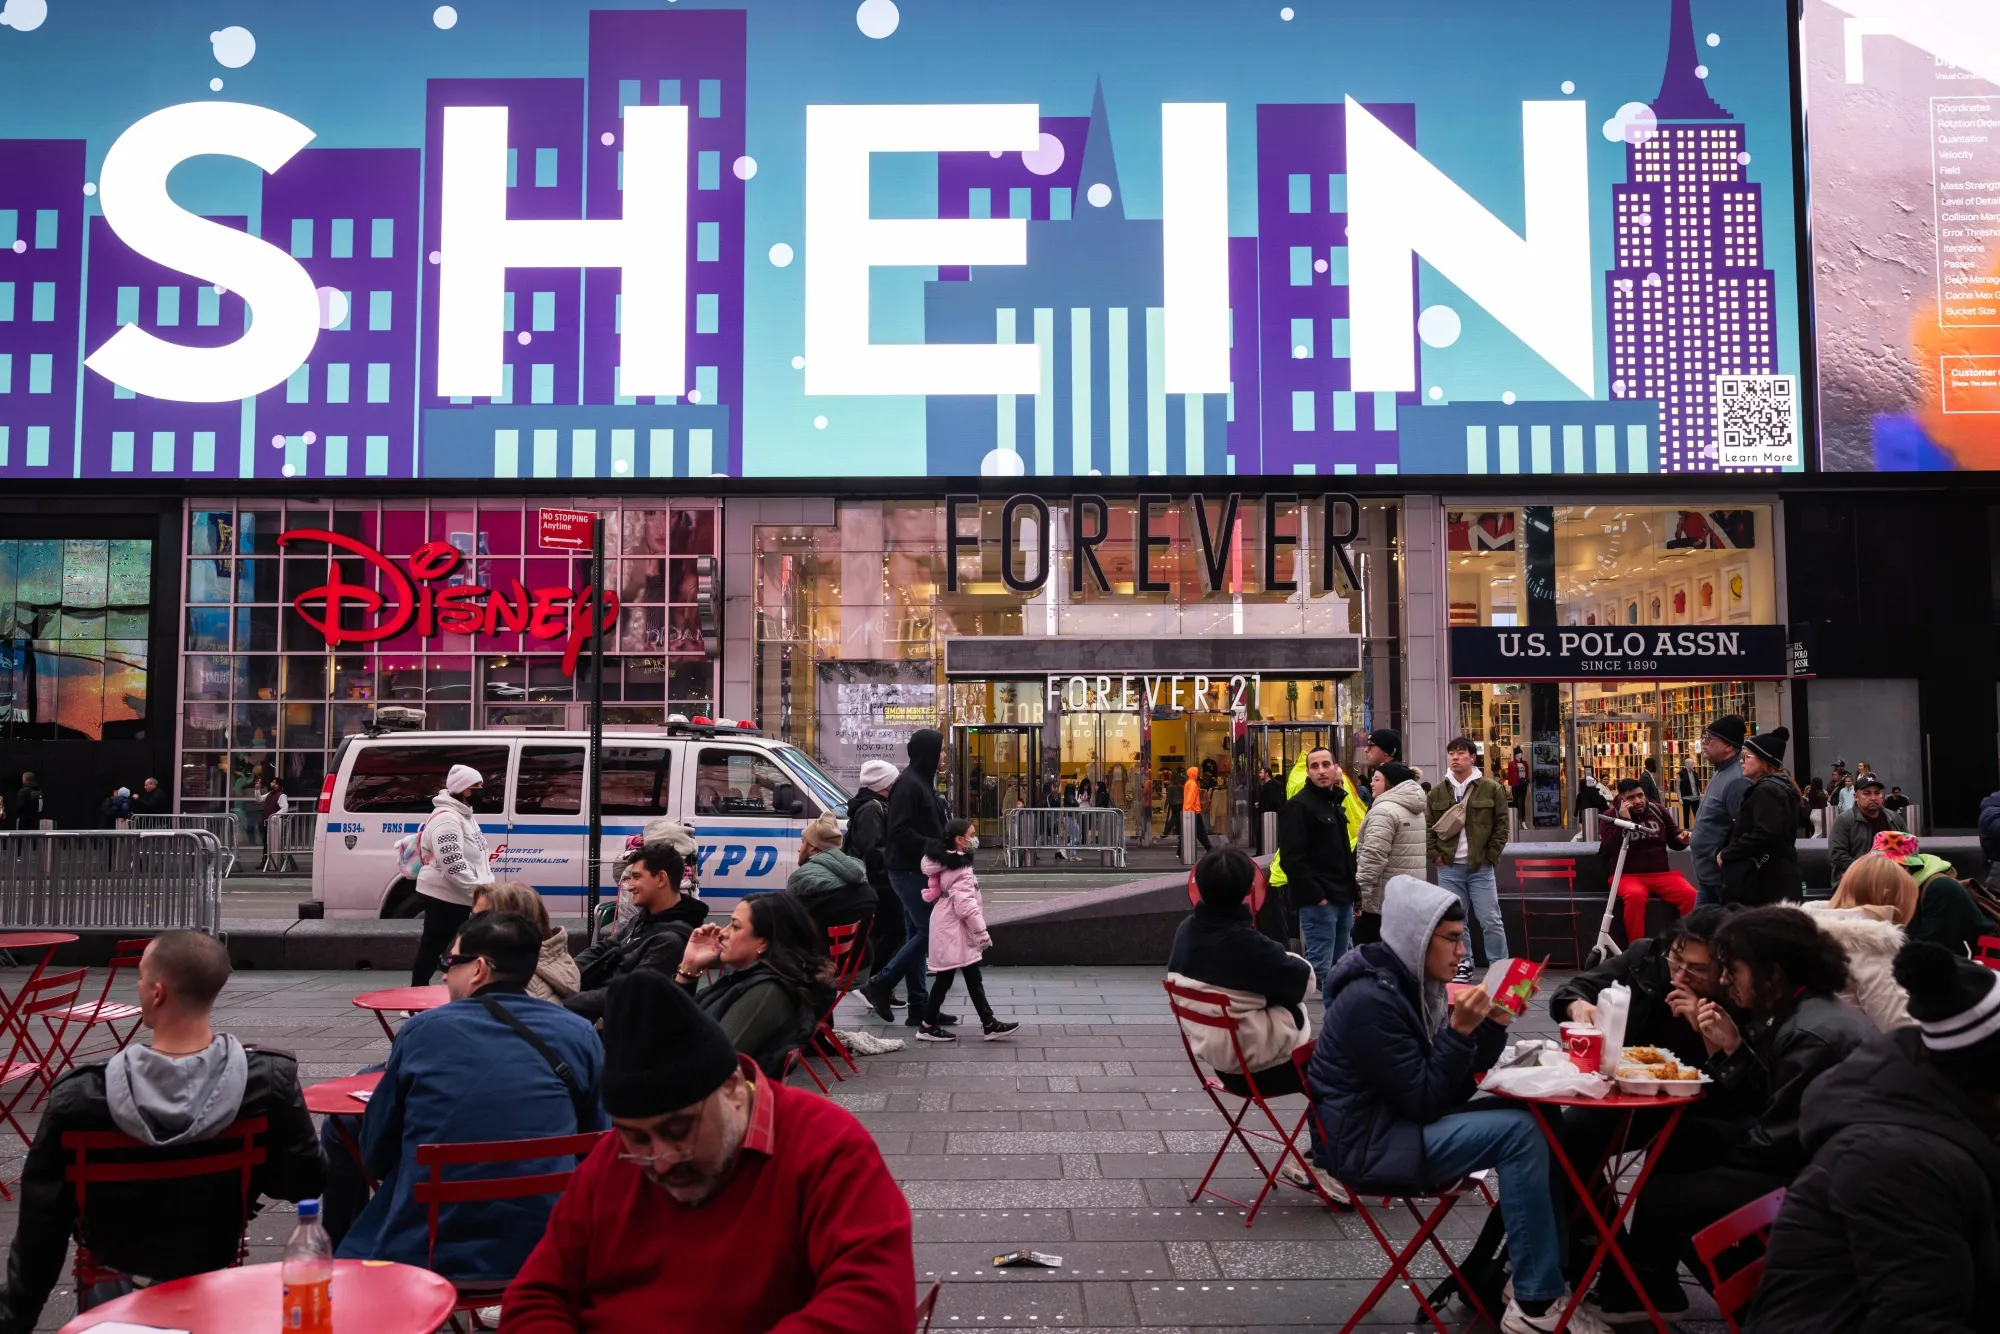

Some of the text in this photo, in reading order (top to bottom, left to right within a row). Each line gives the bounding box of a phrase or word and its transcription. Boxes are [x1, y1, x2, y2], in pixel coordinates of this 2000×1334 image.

[1937, 104, 1991, 112] Coordinates
[1938, 119, 1975, 128] Rotation
[1938, 135, 1988, 144] Quantation
[1939, 150, 1974, 160] Velocity
[1940, 166, 1960, 175] Field
[1940, 182, 1964, 190] Mass
[1942, 196, 2000, 206] Level of Detail
[1942, 213, 1979, 221] Collision
[1942, 229, 1964, 237] Error
[84, 93, 1596, 403] SHEIN
[1943, 244, 1985, 253] Iterations
[1944, 260, 1976, 269] Passes
[1945, 291, 1974, 300] Cache
[1975, 291, 1993, 299] Max
[1946, 306, 1997, 316] Bucket Size
[1952, 368, 1998, 377] Customer
[1725, 452, 1793, 462] Learn More
[542, 512, 589, 523] NO STOPPING
[543, 521, 572, 531] Anytime
[945, 493, 1362, 595] FOREVER
[1498, 632, 1746, 657] U.S. POLO ASSN.
[1794, 650, 1808, 659] POLO
[1581, 660, 1657, 671] SINCE 1890
[1047, 674, 1261, 711] FOREVER 21
[875, 743, 894, 751] 9-12
[343, 822, 361, 833] 8534
[382, 822, 403, 833] PBMS
[495, 844, 545, 854] COURTESY
[488, 853, 570, 864] PROFESSIONALISM
[697, 844, 778, 877] YPD
